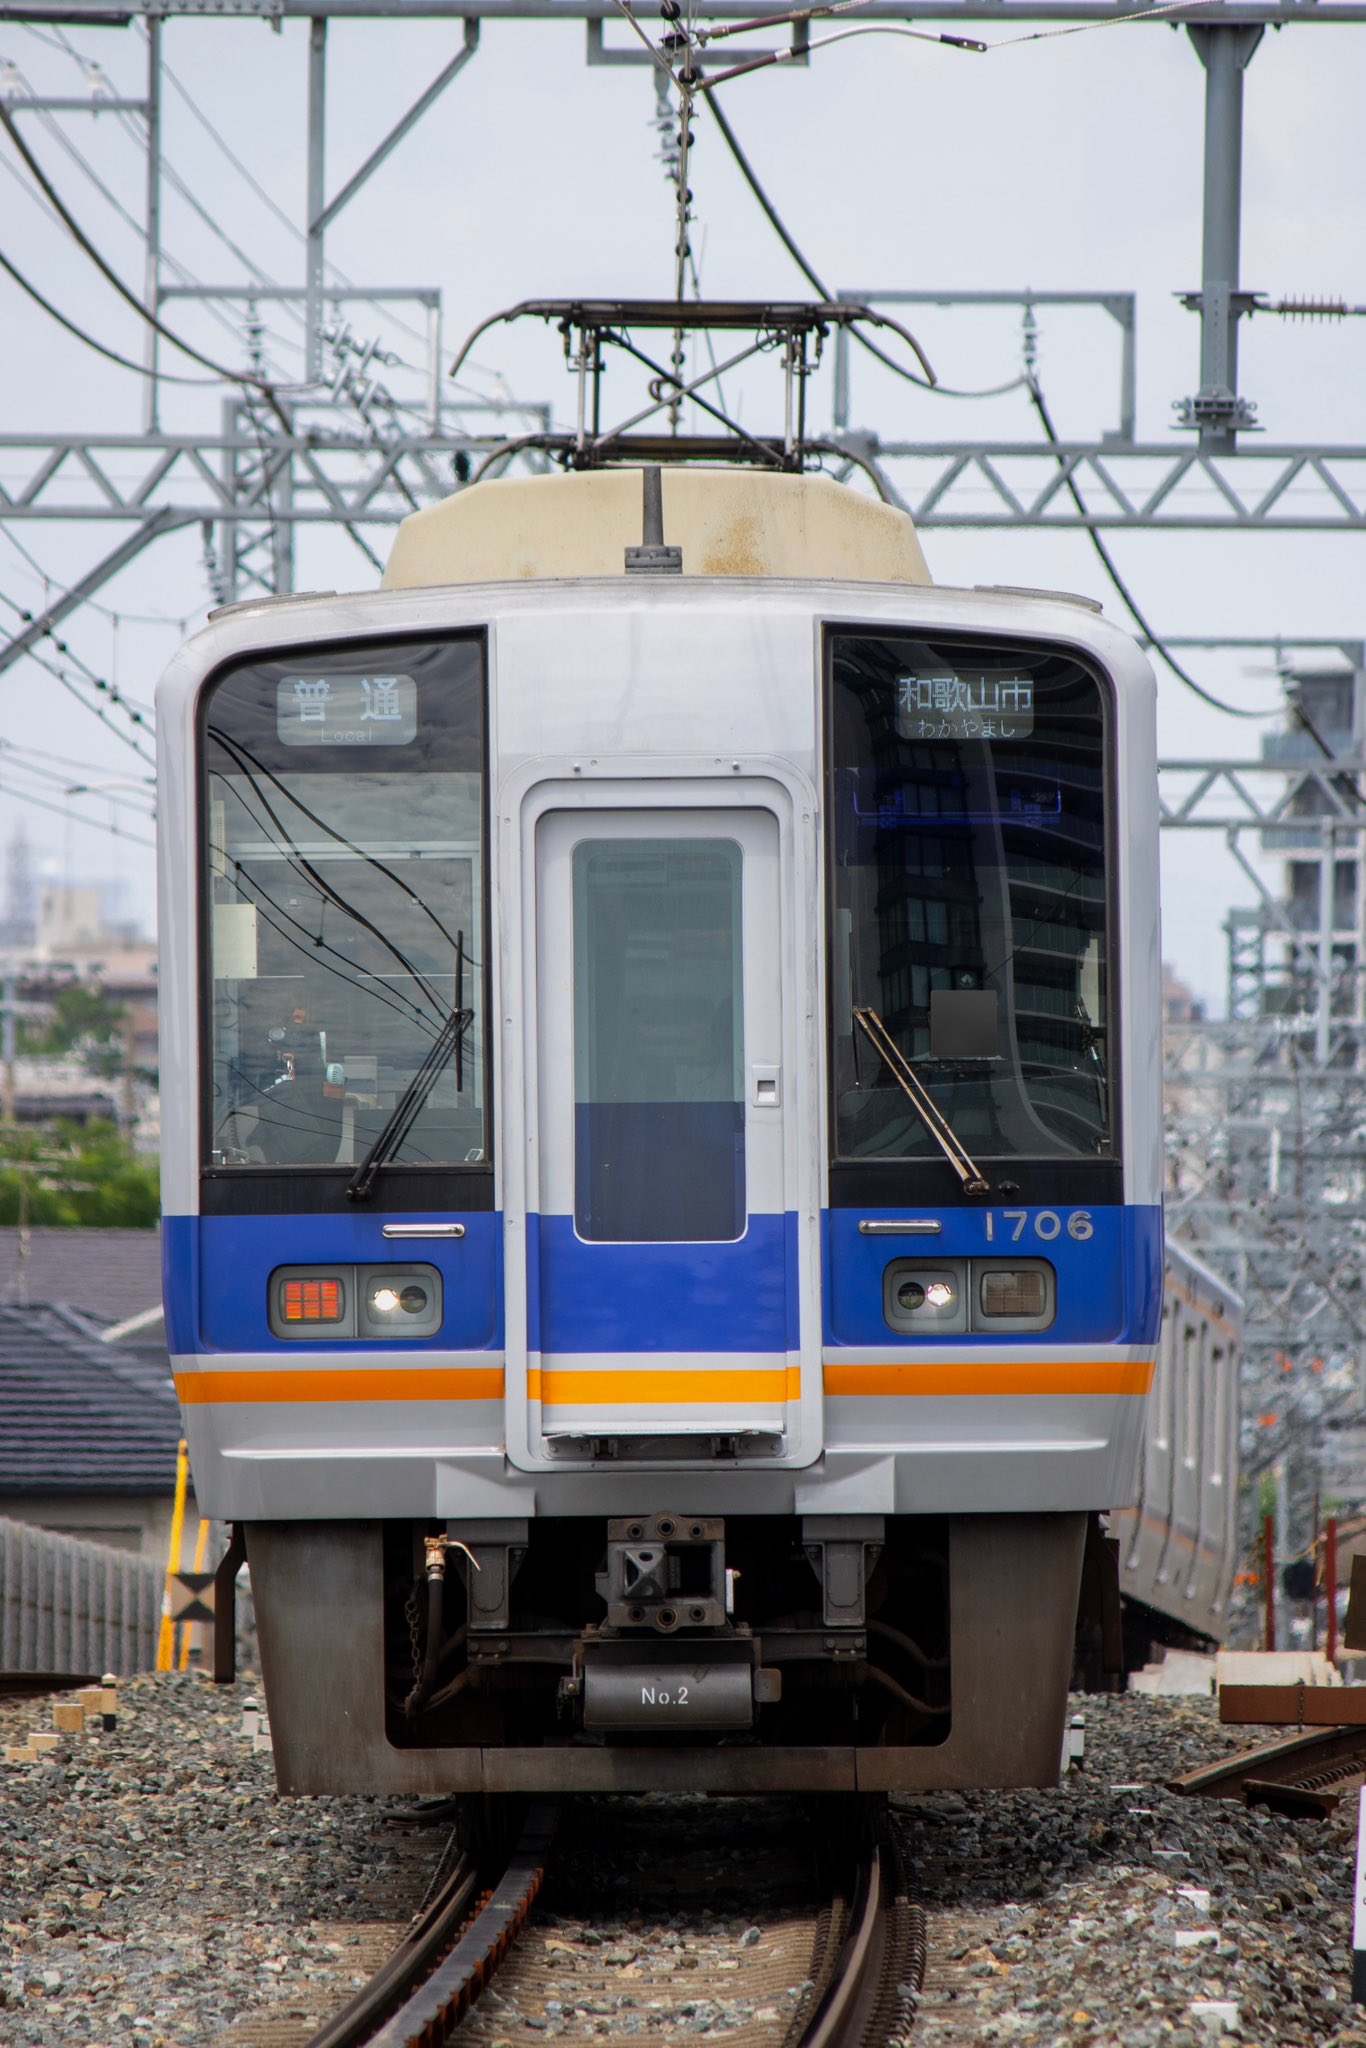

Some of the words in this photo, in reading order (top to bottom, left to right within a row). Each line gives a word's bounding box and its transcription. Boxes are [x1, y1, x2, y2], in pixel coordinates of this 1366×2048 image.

[292, 678, 402, 722] 普通
[899, 676, 1034, 712] 和歌山市
[321, 727, 372, 743] Local
[918, 719, 1015, 738] わかやまし
[986, 1210, 1094, 1241] 1706
[641, 1686, 689, 1705] No.2
